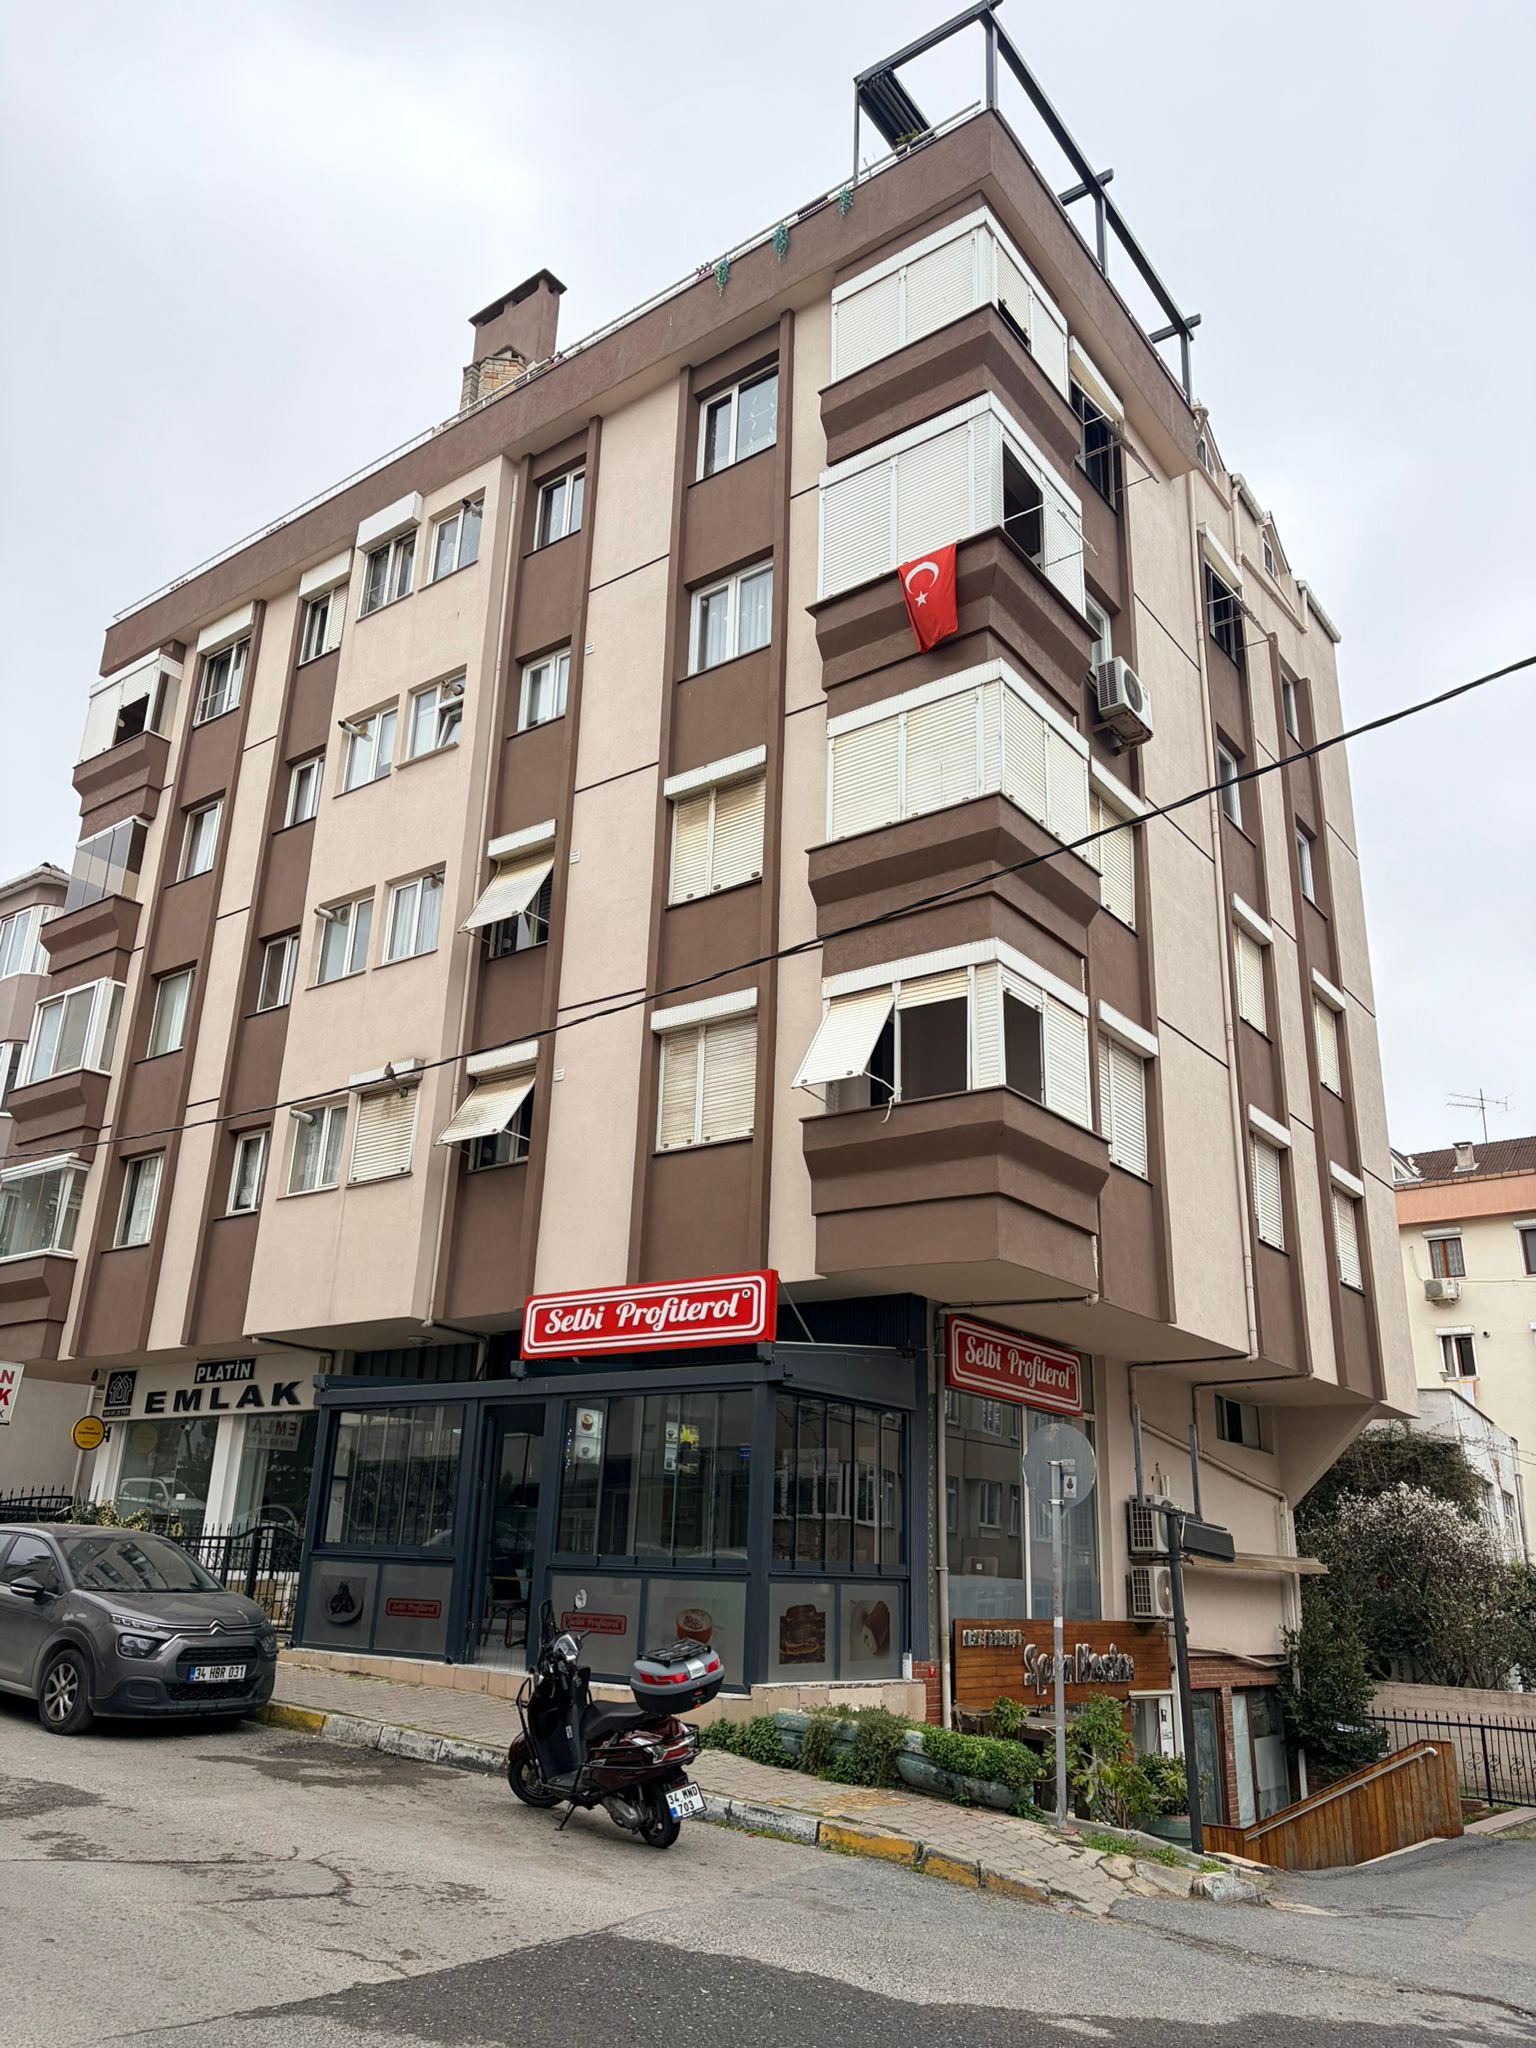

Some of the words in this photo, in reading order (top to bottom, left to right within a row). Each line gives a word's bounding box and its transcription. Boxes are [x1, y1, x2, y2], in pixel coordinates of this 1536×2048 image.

[544, 1306, 605, 1335] Selbi
[965, 1336, 1001, 1371] Selbi
[196, 1360, 252, 1383] PLATİN
[144, 1381, 302, 1415] EMLAK
[195, 1668, 206, 1680] 34
[209, 1667, 226, 1679] HBR
[228, 1666, 244, 1678] 031
[668, 1793, 680, 1805] 34
[678, 1800, 695, 1814] 703
